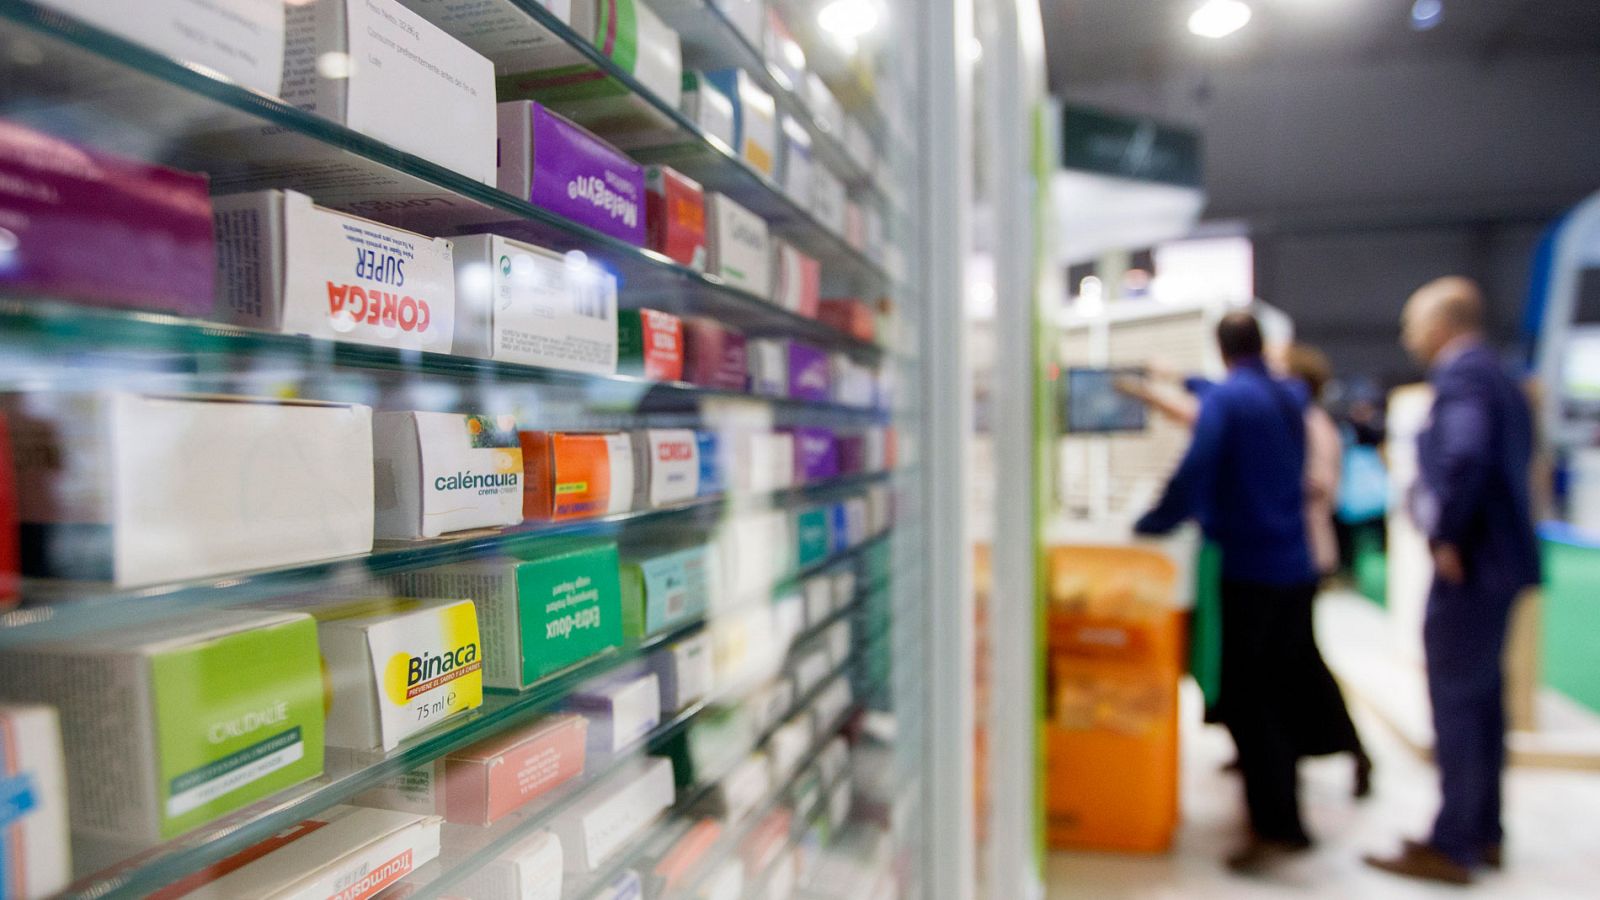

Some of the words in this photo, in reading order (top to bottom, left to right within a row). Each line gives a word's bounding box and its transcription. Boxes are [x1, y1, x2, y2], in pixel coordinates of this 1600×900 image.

[356, 247, 405, 287] SUPER
[326, 280, 430, 333] COREGA
[478, 488, 498, 496] crema
[546, 605, 600, 640] Extra-doux
[408, 643, 476, 687] Binaca
[417, 701, 429, 720] 75
[432, 696, 444, 714] ml
